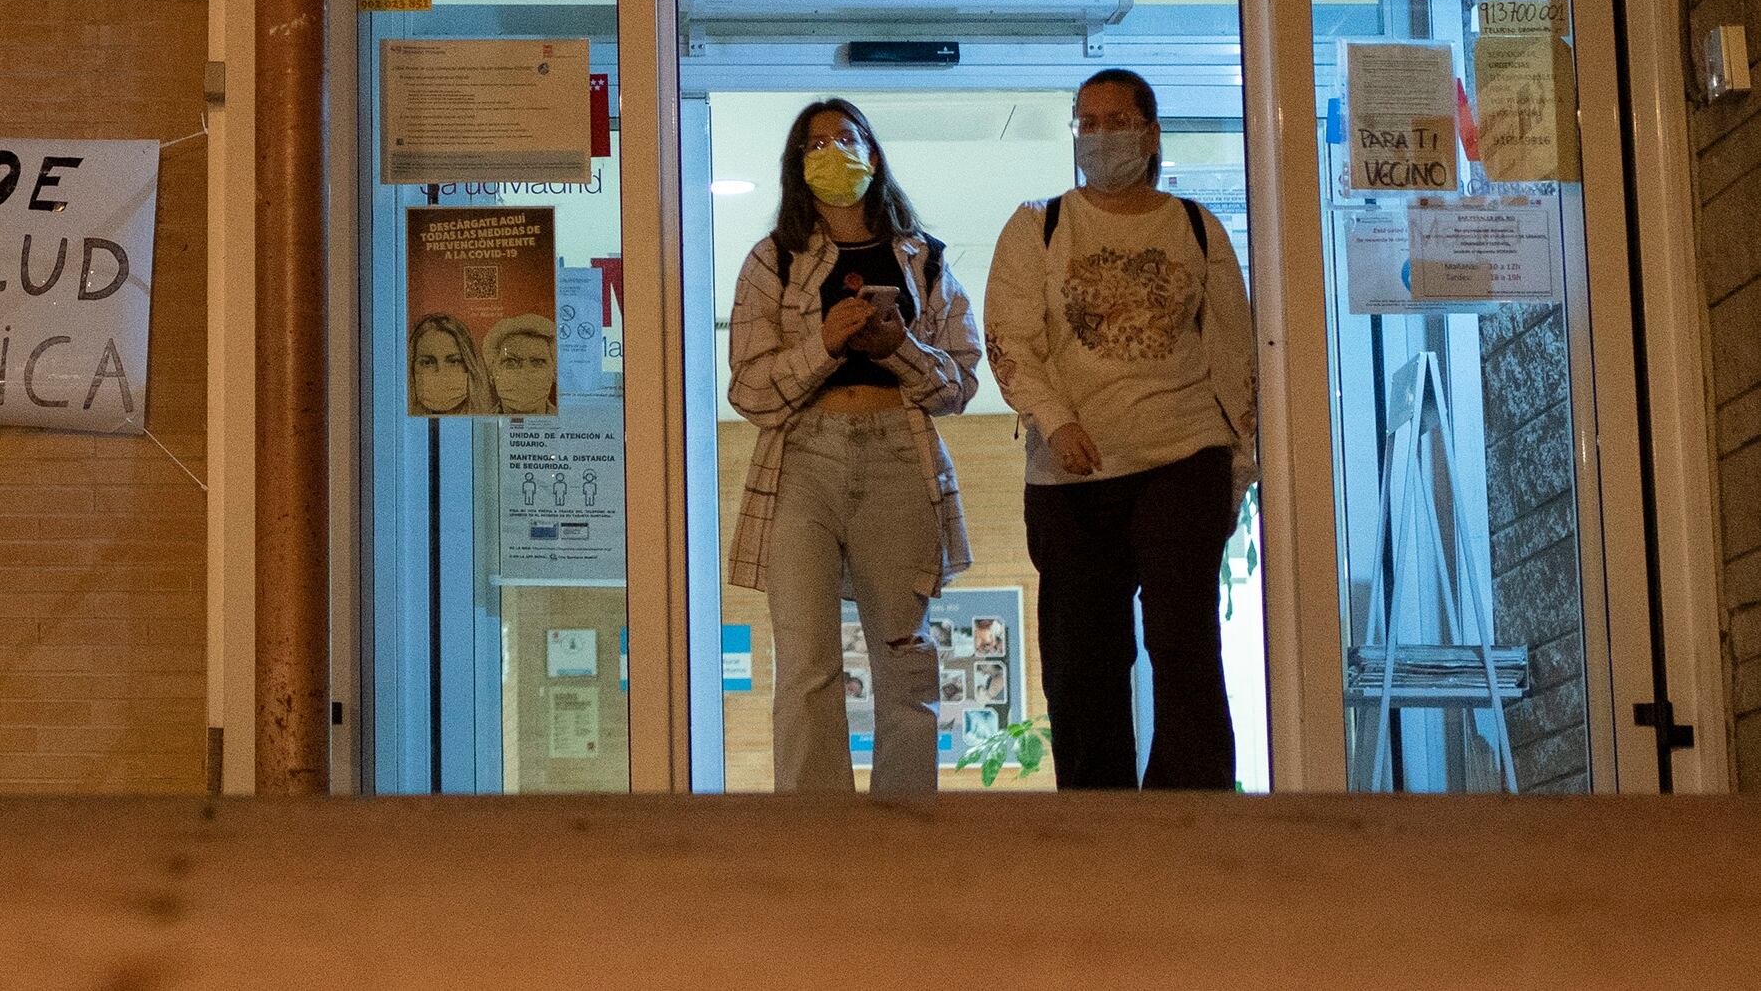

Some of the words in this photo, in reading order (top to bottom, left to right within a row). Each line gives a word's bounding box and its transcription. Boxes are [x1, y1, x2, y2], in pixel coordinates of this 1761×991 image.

[1357, 128, 1409, 149] PARA
[420, 230, 456, 242] TODAS
[457, 229, 477, 240] LAS
[478, 226, 526, 239] MEDIDAS
[526, 224, 541, 234] DE
[426, 238, 495, 251] PREVENCIÓN
[496, 236, 536, 248] FRENTE
[454, 251, 467, 259] LA
[469, 248, 518, 259] COVID-19
[559, 431, 601, 440] ATENCIÓN
[509, 440, 548, 448] USUARIO.
[509, 462, 521, 470] DE
